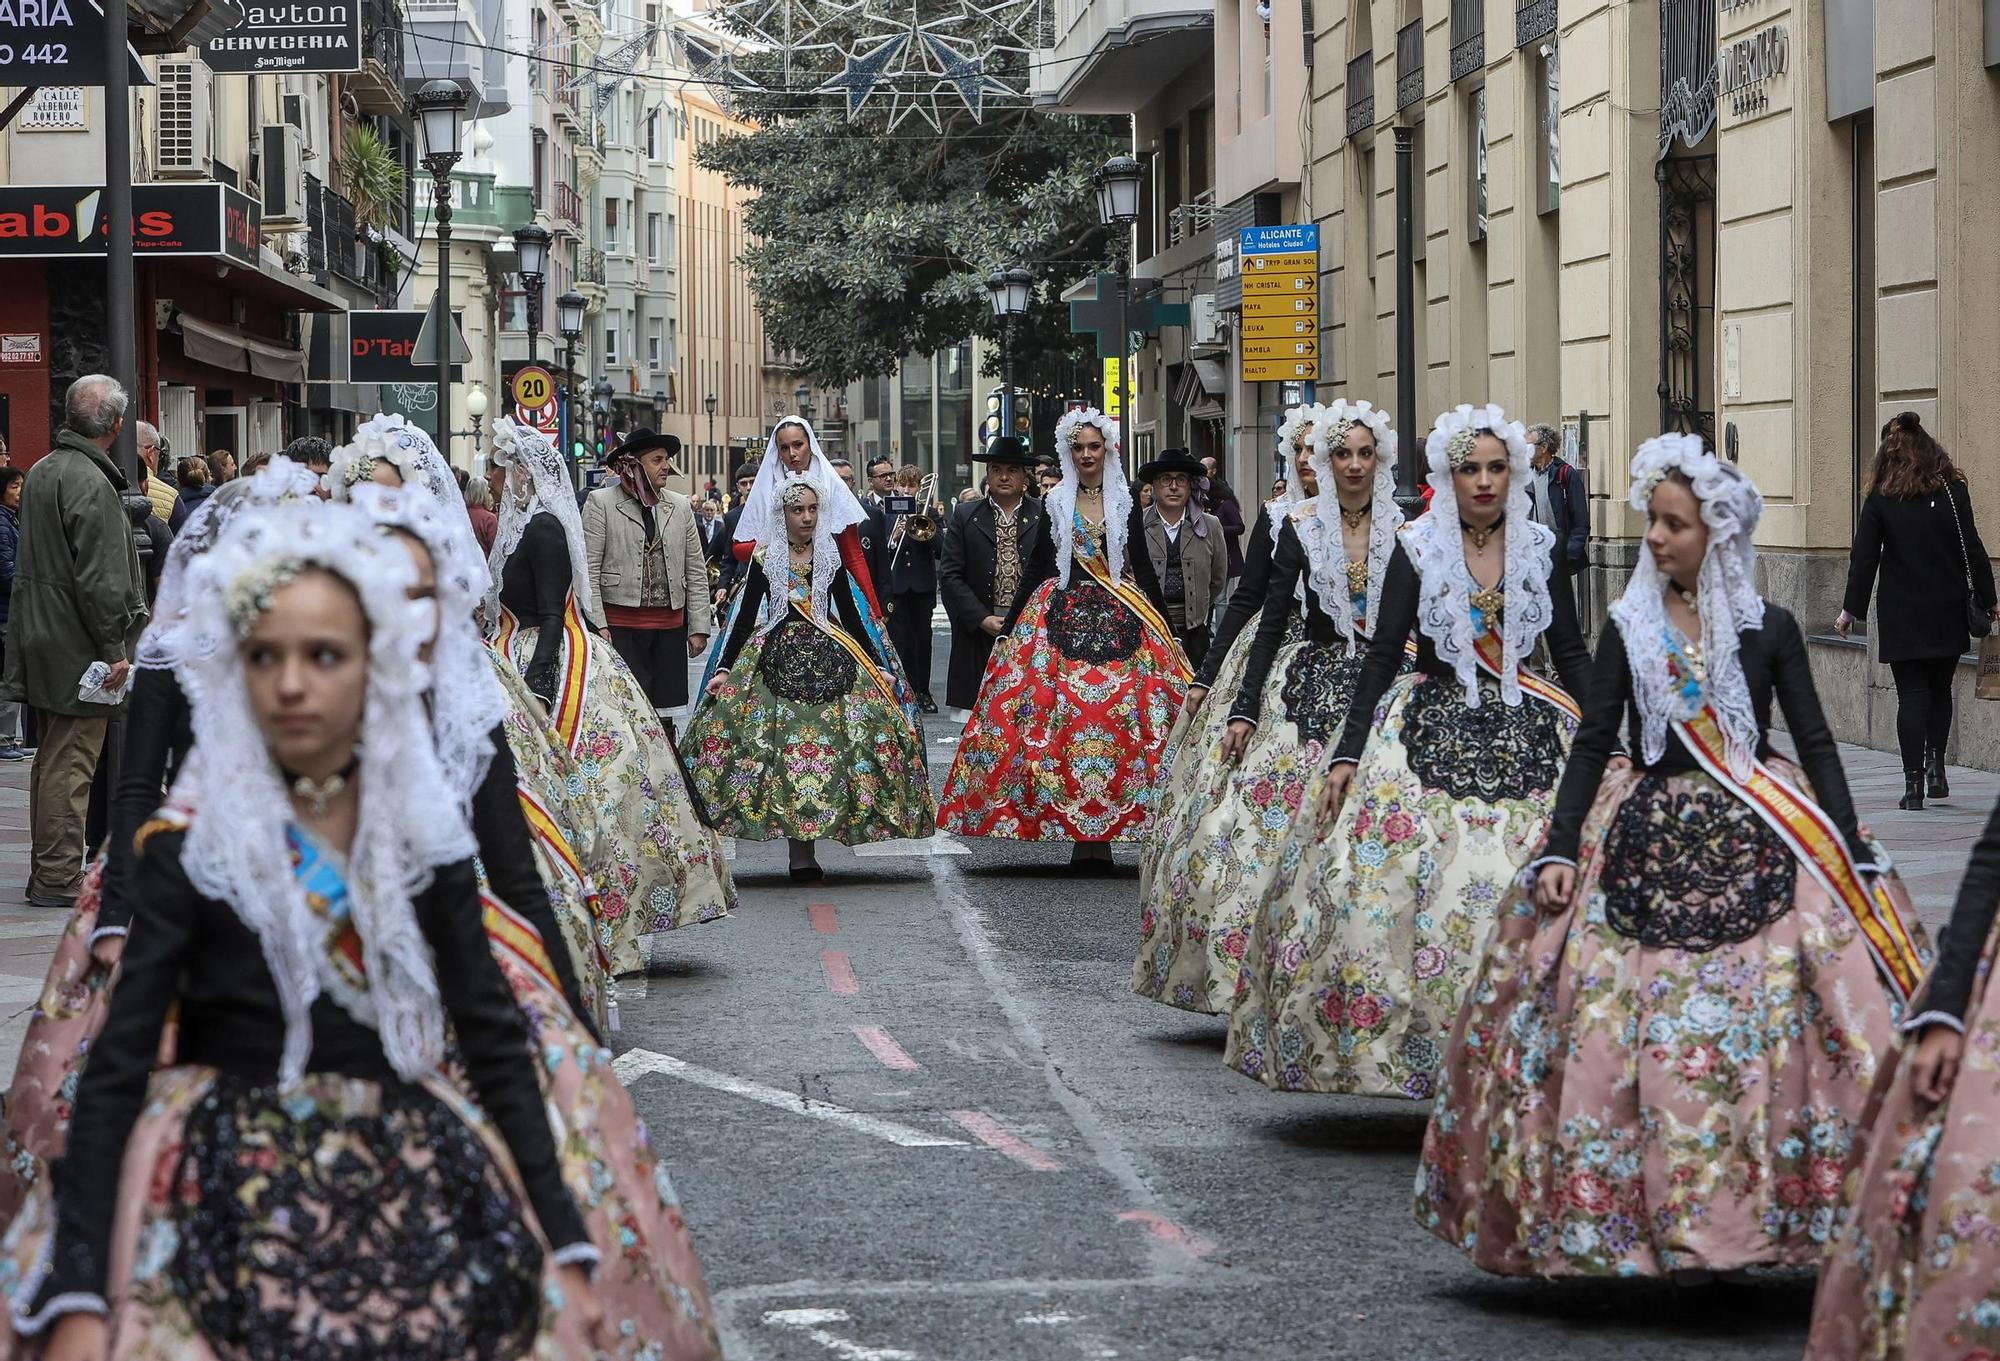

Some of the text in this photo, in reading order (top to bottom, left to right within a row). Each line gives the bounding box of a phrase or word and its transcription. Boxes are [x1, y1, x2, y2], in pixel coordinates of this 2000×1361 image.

[210, 35, 348, 51] CERVECERIA
[22, 43, 68, 64] 442
[44, 91, 80, 101] CALLE
[37, 102, 78, 111] ALBEROLA
[33, 112, 71, 121] ROMERO
[1260, 229, 1302, 240] ALICANTE
[1283, 240, 1304, 248] Ciudad
[1256, 281, 1282, 289] CRISTAL
[522, 379, 544, 398] 20
